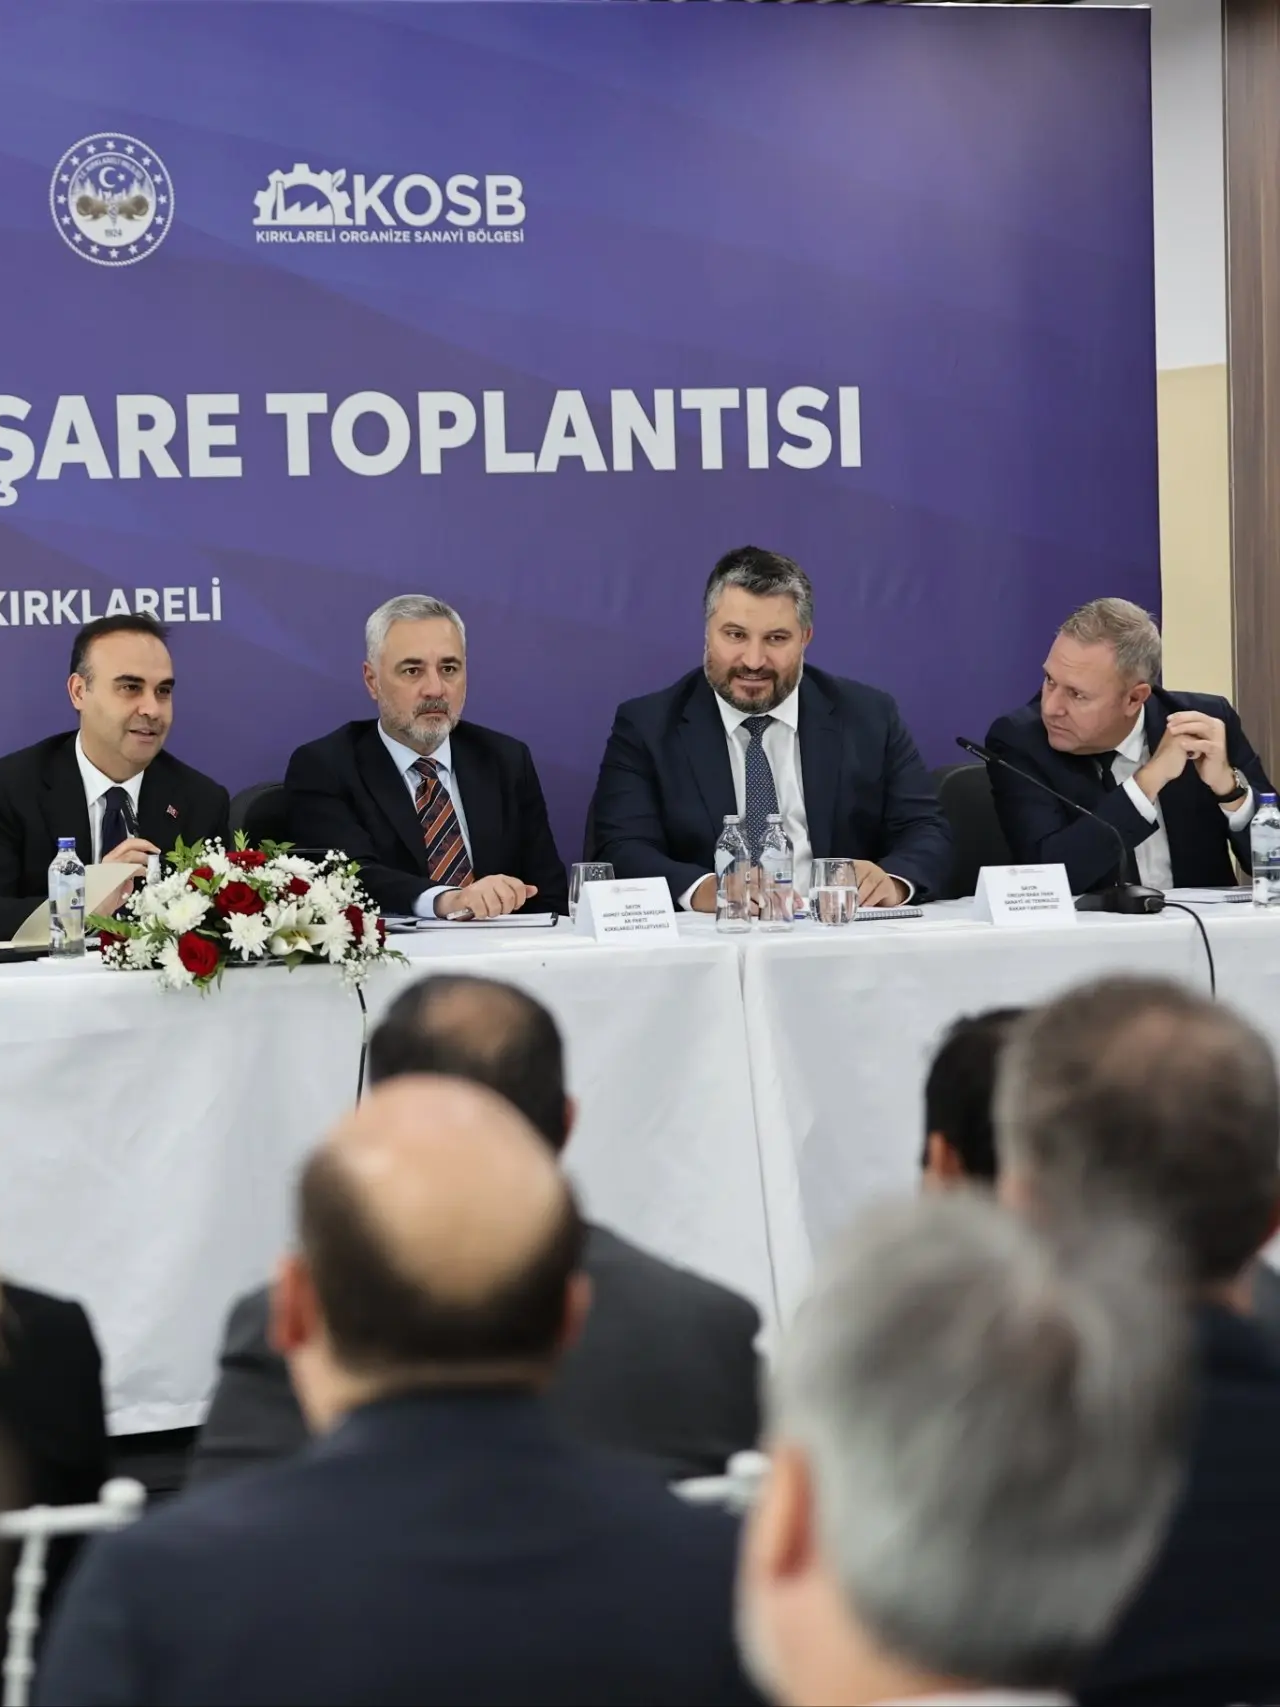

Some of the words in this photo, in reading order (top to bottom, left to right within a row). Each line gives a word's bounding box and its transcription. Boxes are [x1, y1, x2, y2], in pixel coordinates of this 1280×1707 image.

[354, 174, 525, 227] KOSB
[256, 229, 336, 243] KIRKLARELİ
[339, 229, 411, 243] ORGANİZE
[414, 228, 464, 243] SANAYİ
[467, 227, 524, 243] BÖLGESİ
[265, 385, 863, 478] TOPLANTISI
